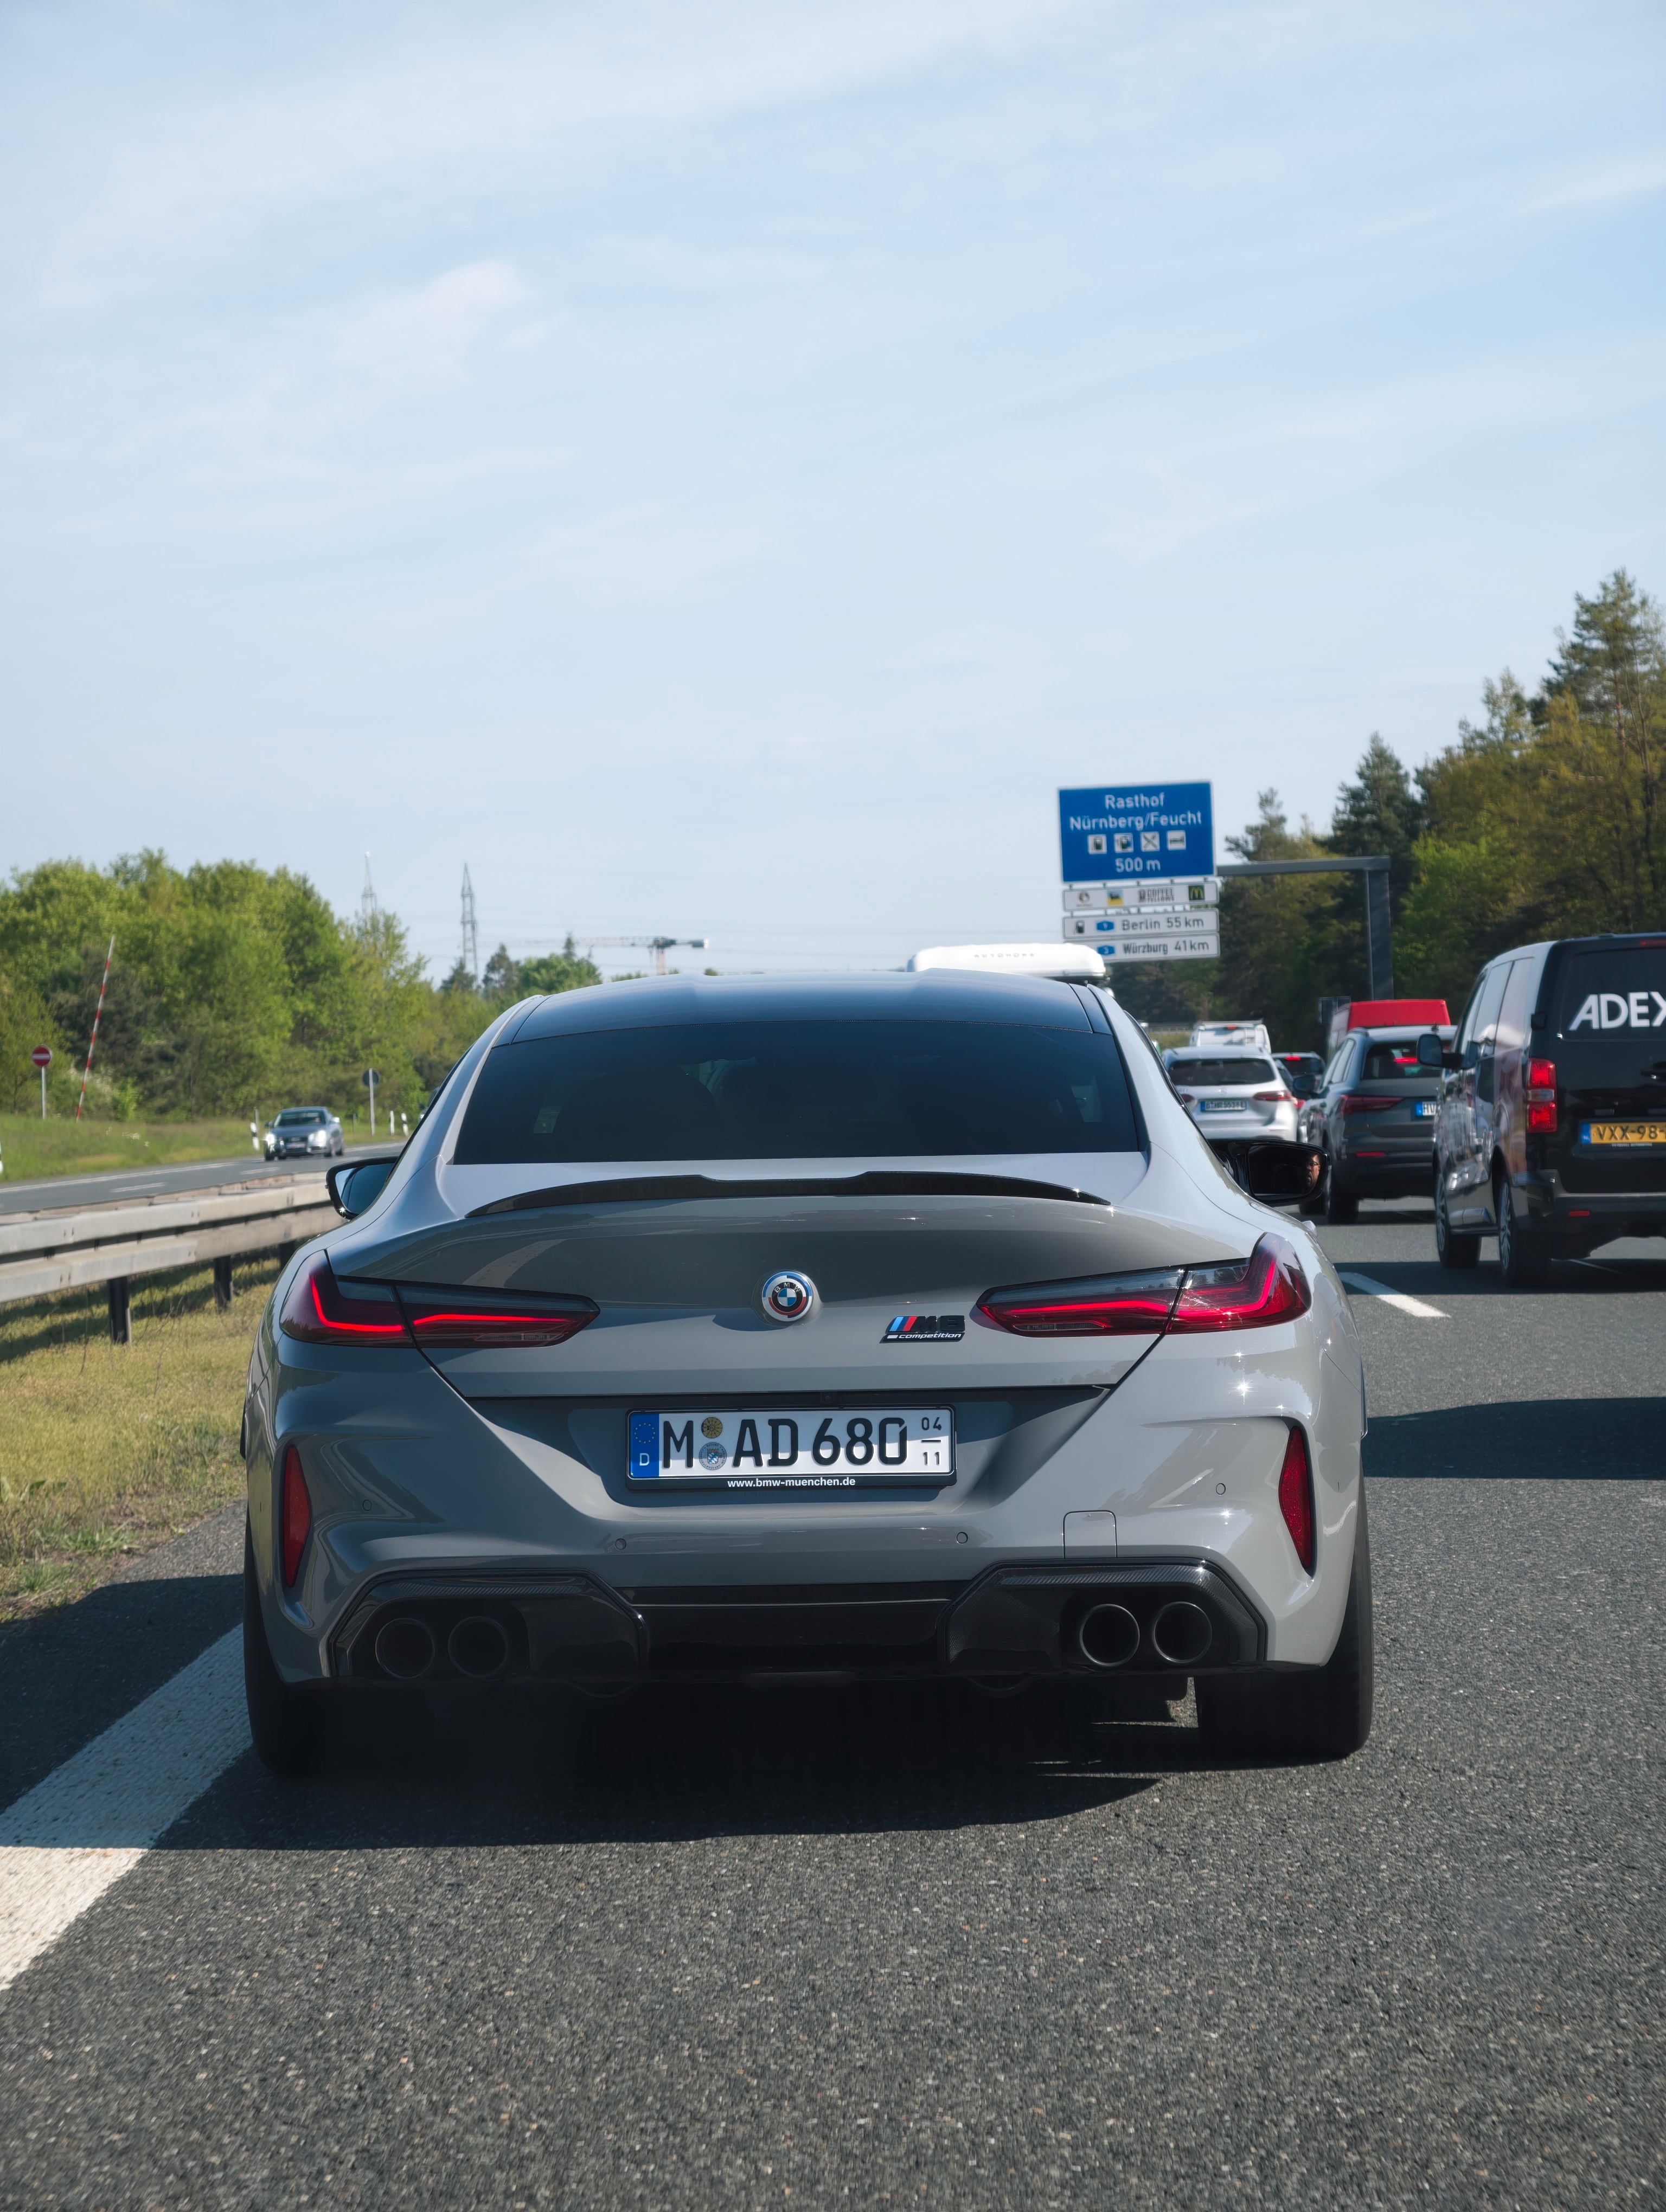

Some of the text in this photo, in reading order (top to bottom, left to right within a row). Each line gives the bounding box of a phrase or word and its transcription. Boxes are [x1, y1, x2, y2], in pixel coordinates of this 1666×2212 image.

[1105, 792, 1164, 809] Rasthof
[1069, 810, 1202, 831] Nürnberg/Feucht
[1115, 857, 1161, 872] 500 m
[1122, 918, 1161, 931] Berlin
[1167, 917, 1181, 928] 55
[1185, 916, 1204, 928] km
[1123, 942, 1168, 955] Würzburg
[1174, 940, 1187, 951] 41
[1190, 940, 1209, 951] km
[1597, 1125, 1666, 1141] VXX-98-
[774, 1282, 801, 1294] BMW
[921, 1417, 942, 1430] 04
[663, 1420, 694, 1468] M
[732, 1419, 799, 1467] AD
[813, 1418, 907, 1466] 680
[639, 1453, 649, 1466] D
[924, 1451, 941, 1466] 11
[727, 1477, 856, 1488] www.bmw-muenchen.de
